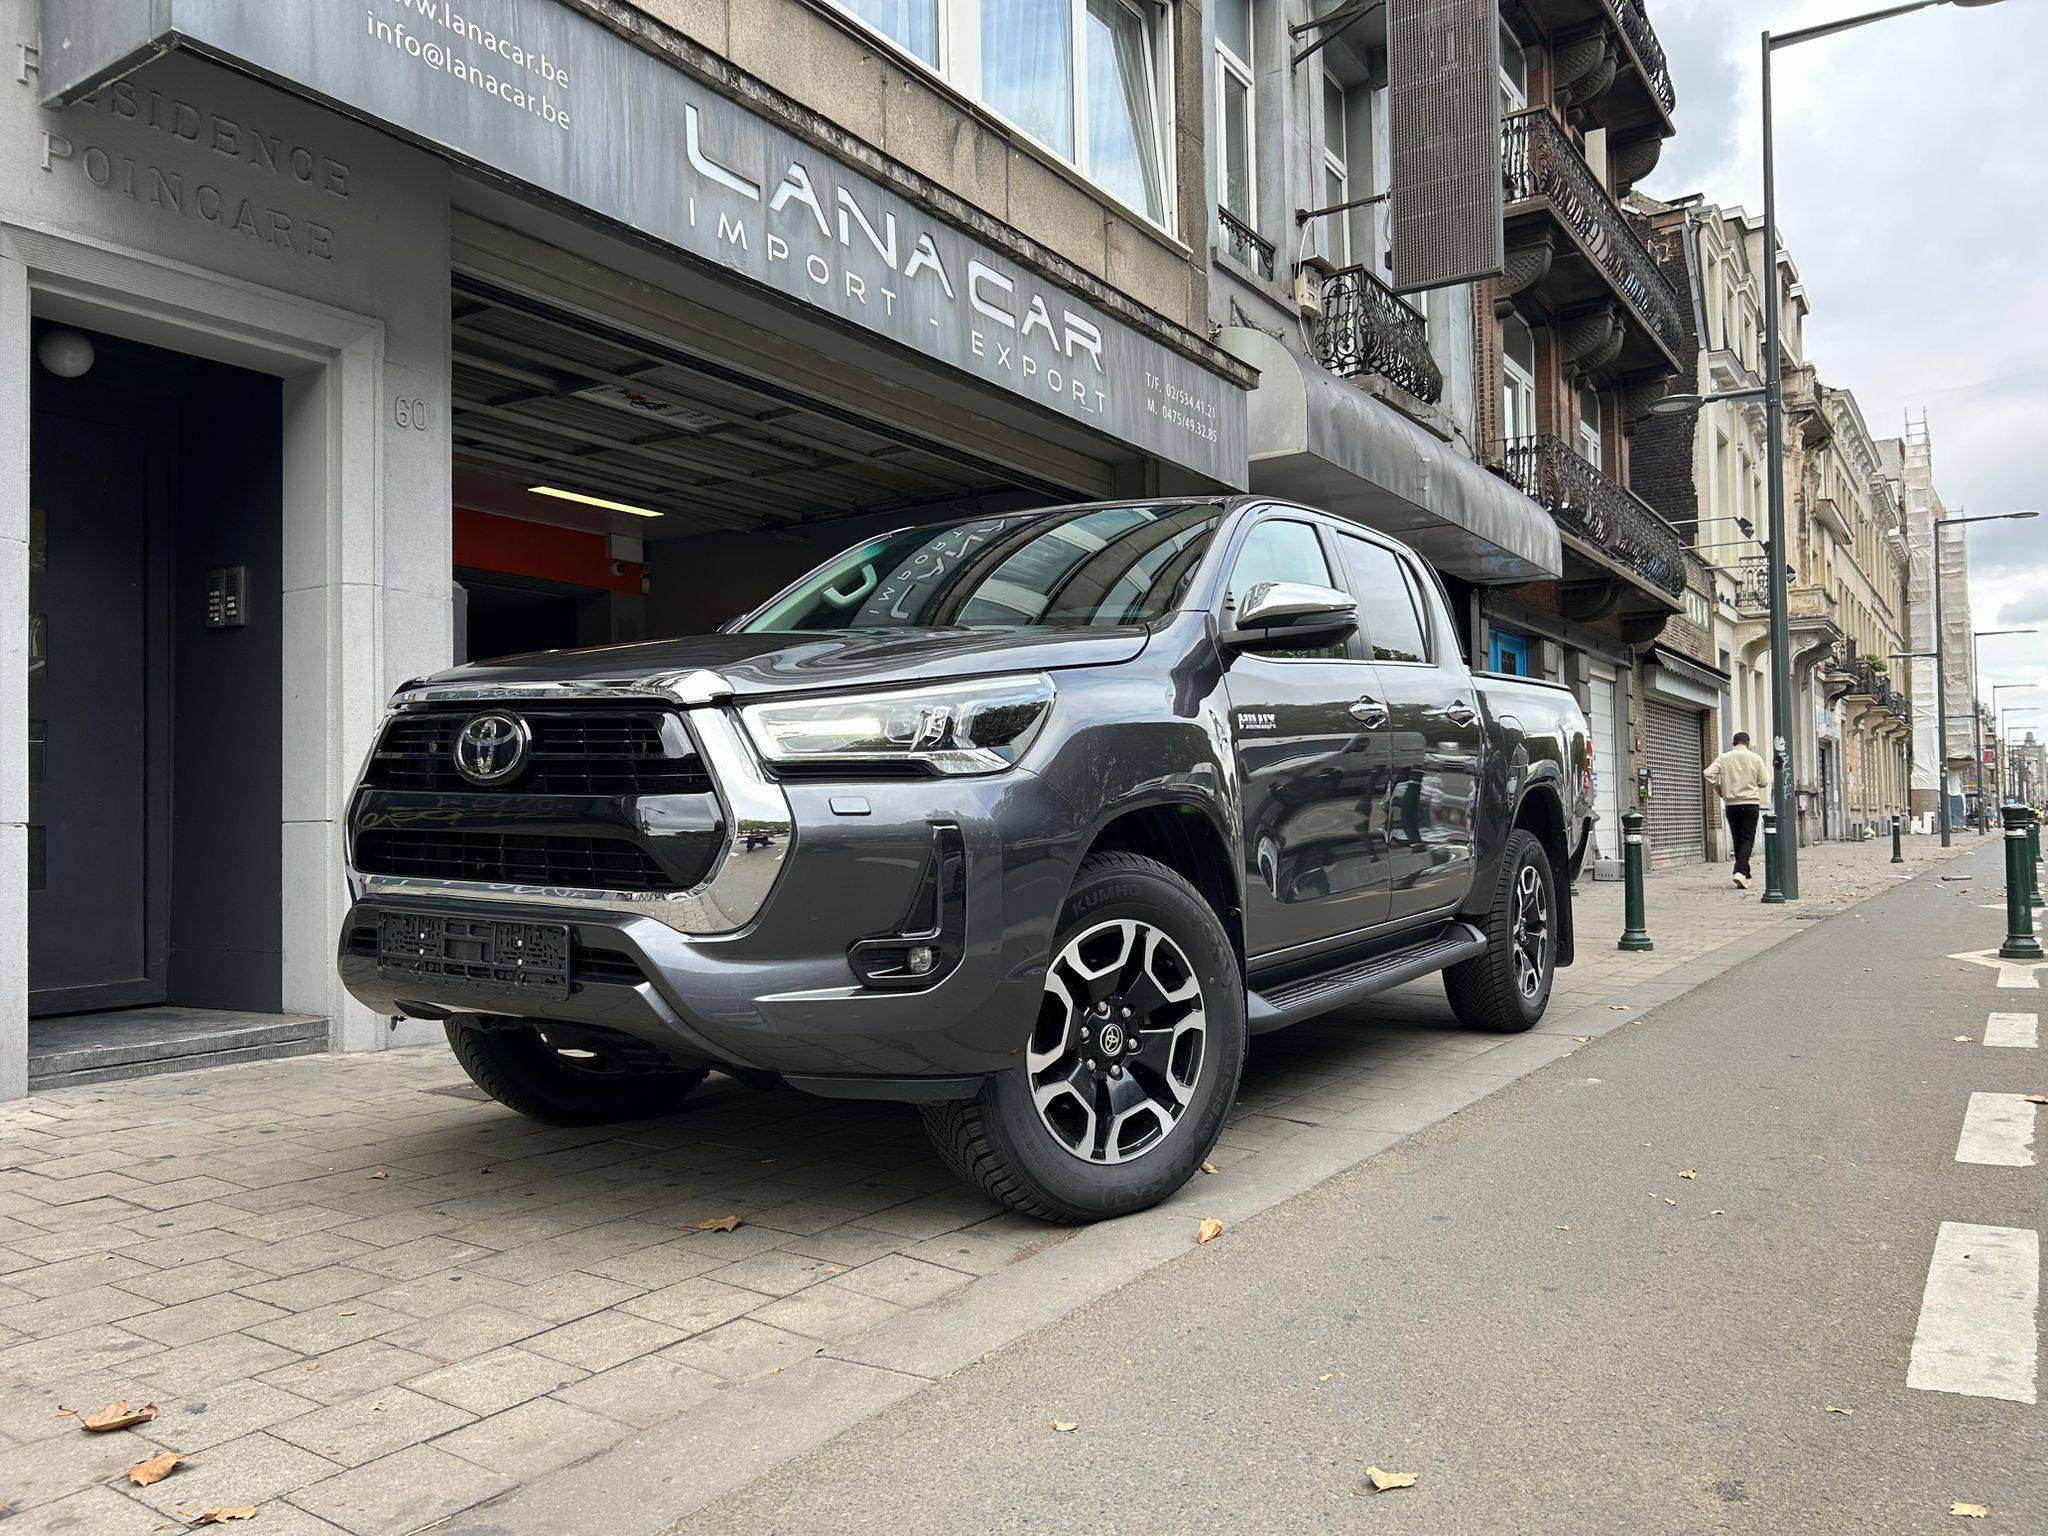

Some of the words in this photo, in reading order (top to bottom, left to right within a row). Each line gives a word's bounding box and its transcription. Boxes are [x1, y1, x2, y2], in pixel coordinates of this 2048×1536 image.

[367, 10, 571, 130] info@lanacar.be
[40, 130, 333, 261] POINCARE
[686, 103, 1103, 373] LANACAR
[690, 197, 896, 316] IMPORT
[971, 330, 1106, 413] EXPORT
[394, 394, 426, 431] 60
[1147, 397, 1158, 415] M.
